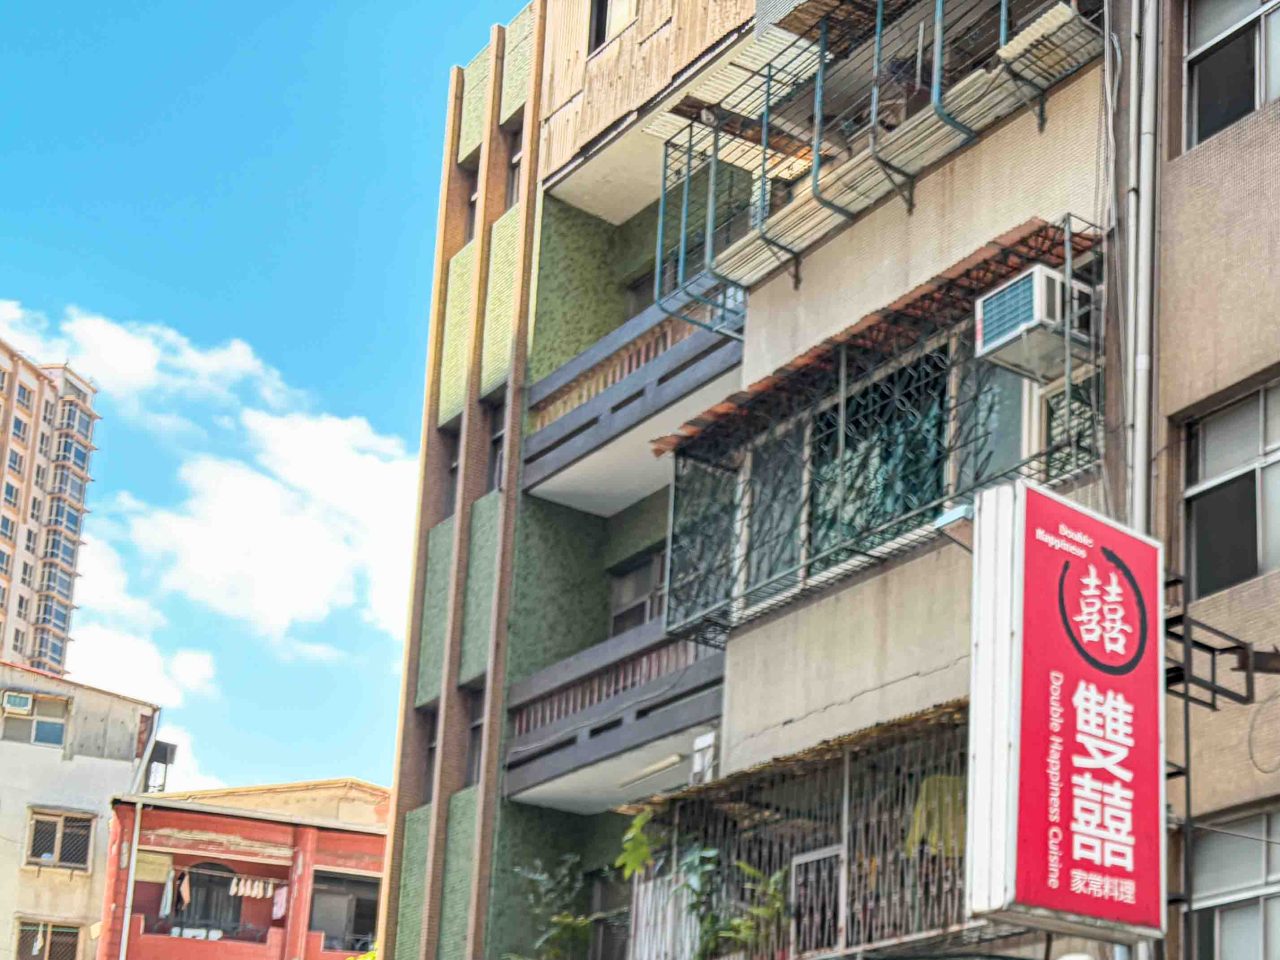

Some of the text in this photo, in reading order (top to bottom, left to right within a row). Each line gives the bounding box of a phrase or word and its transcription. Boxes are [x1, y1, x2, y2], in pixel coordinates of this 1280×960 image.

[1035, 528, 1087, 558] Happiness
[1058, 523, 1094, 547] Double
[1072, 563, 1133, 655] 囍
[1047, 671, 1064, 889] Double Happiness Cuisine
[1070, 679, 1136, 872] 雙囍
[1070, 868, 1136, 904] 家常料理
